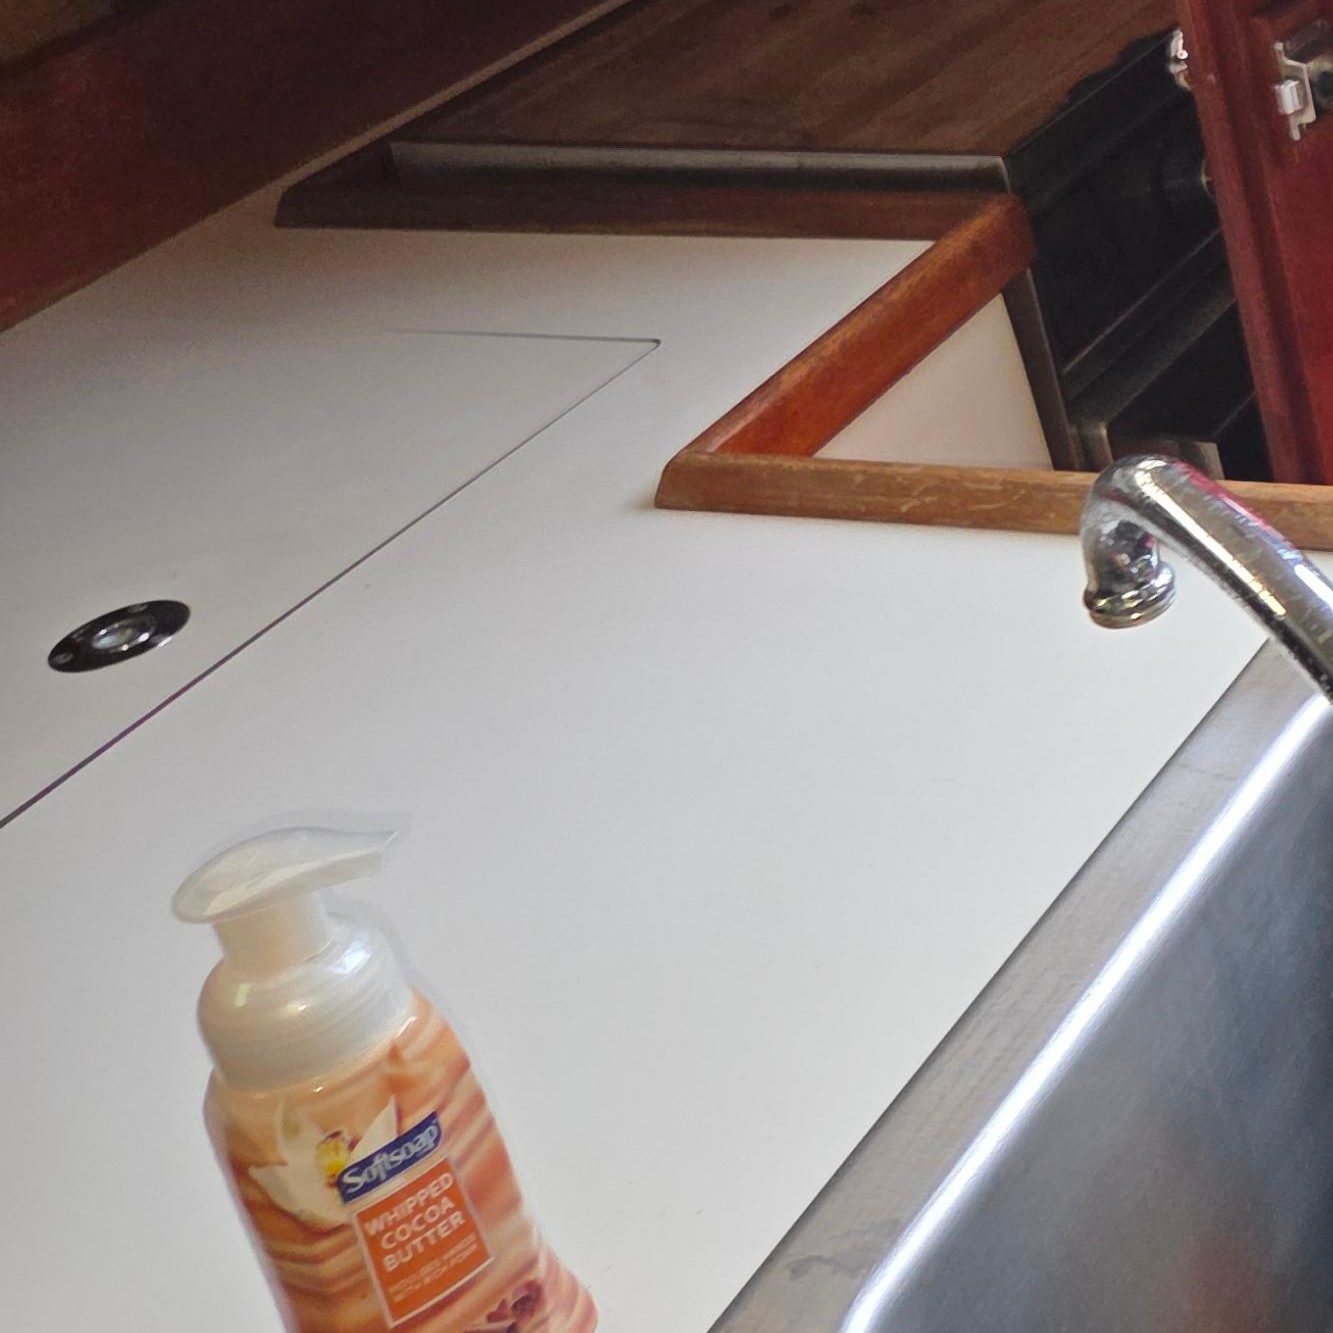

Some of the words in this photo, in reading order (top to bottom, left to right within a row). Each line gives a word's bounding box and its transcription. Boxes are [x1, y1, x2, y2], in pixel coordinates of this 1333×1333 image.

[342, 1123, 438, 1194] Softsoap
[364, 1172, 454, 1236] WHIPPED
[380, 1196, 455, 1250] COCOA
[382, 1210, 466, 1272] BUTTER
